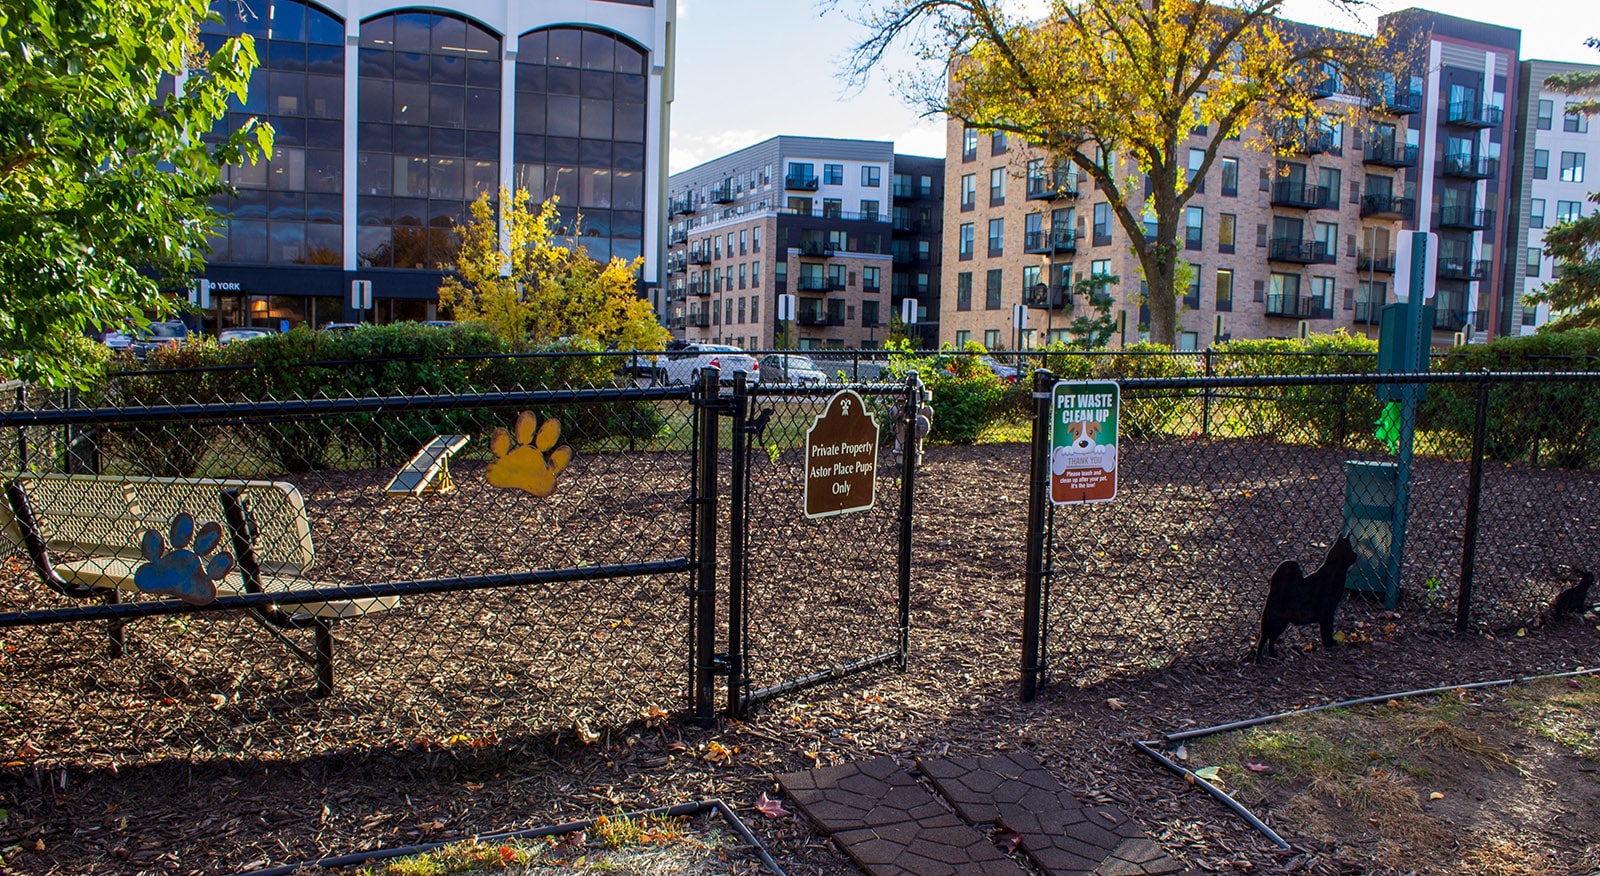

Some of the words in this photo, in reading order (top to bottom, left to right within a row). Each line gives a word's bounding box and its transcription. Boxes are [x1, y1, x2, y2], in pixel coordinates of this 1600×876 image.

[217, 282, 240, 290] YORK
[1057, 394, 1076, 408] PET
[1077, 394, 1113, 408] WASTE
[1062, 410, 1094, 424] CLEAN
[1096, 409, 1110, 423] UP
[812, 444, 839, 457] Private
[841, 442, 873, 457] Property
[1068, 457, 1088, 465] THANK
[810, 466, 832, 478] Astor
[834, 462, 854, 476] Place
[855, 461, 873, 476] Pups
[832, 480, 851, 496] Only
